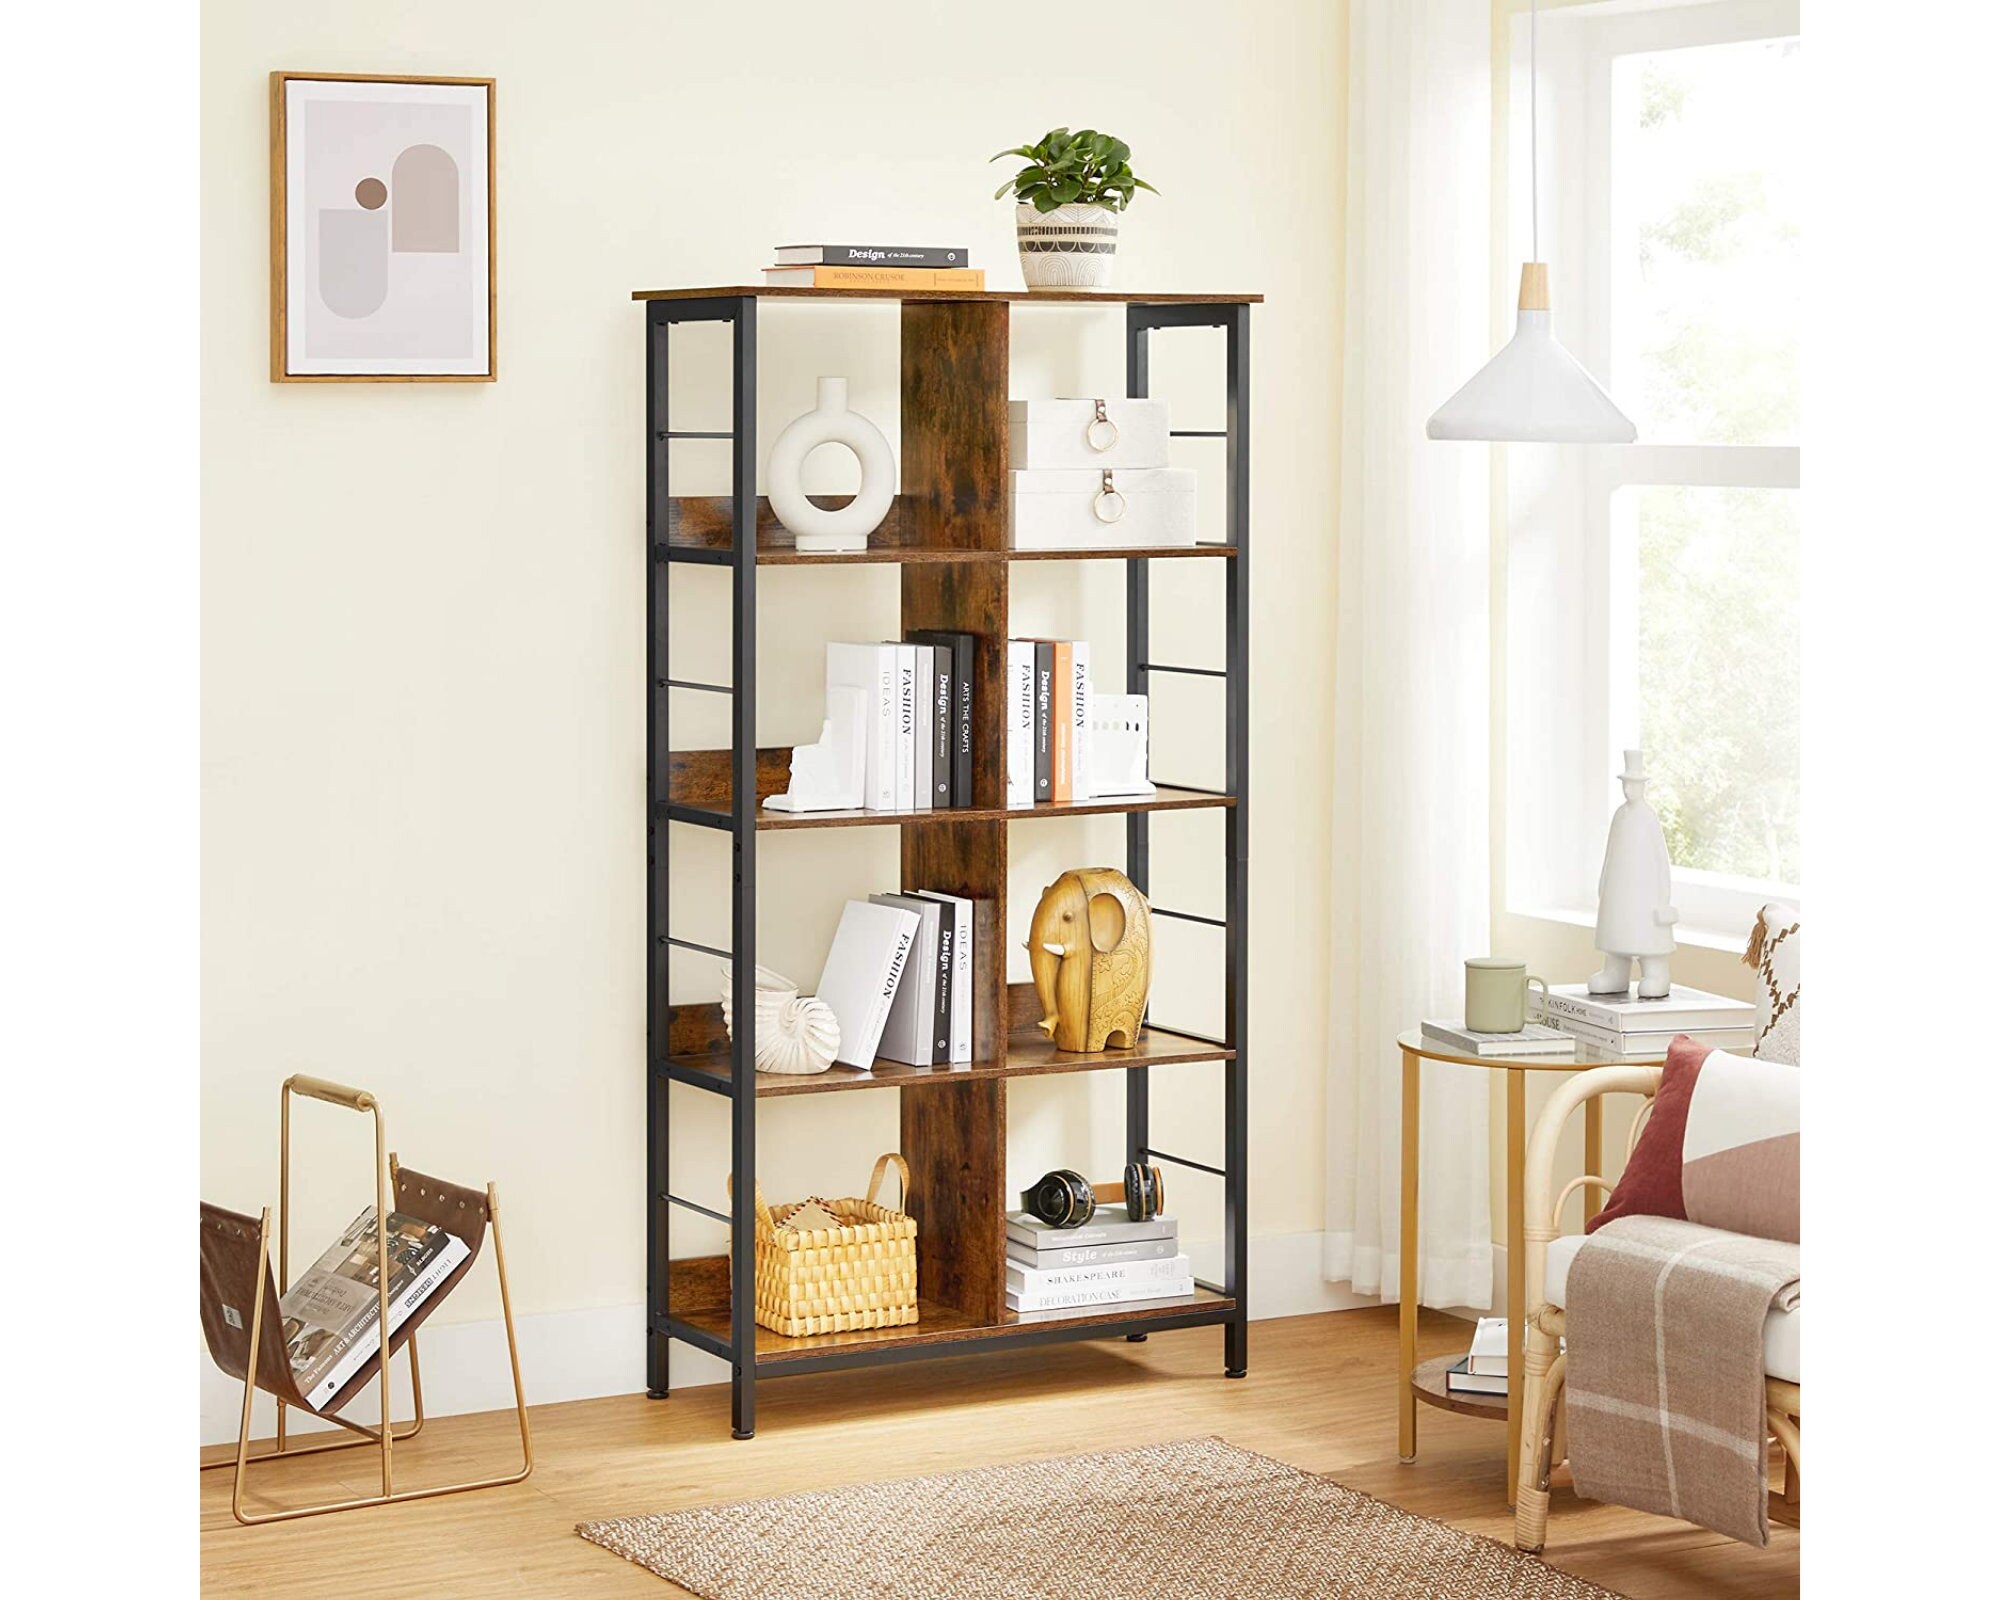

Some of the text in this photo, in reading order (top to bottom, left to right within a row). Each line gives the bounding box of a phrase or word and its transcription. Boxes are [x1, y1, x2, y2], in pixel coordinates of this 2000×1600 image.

[848, 249, 885, 261] Design
[834, 272, 905, 281] ROBINSON CRUSOE
[882, 671, 890, 717] IDEAS
[902, 669, 912, 734] FASHION
[938, 674, 949, 714] Design
[962, 682, 970, 702] ARTS
[1022, 664, 1031, 730] FASHION
[1040, 670, 1050, 710] Design
[1076, 663, 1085, 728] FASHION
[882, 933, 910, 999] FASHION
[940, 930, 952, 970] Design
[1062, 1249, 1097, 1263] Style
[404, 1258, 452, 1309] LIGHT DESIGNS
[1046, 1269, 1126, 1286] SHAKESPEARE
[1040, 1291, 1099, 1307] DECORATION
[333, 1340, 346, 1356] ART
